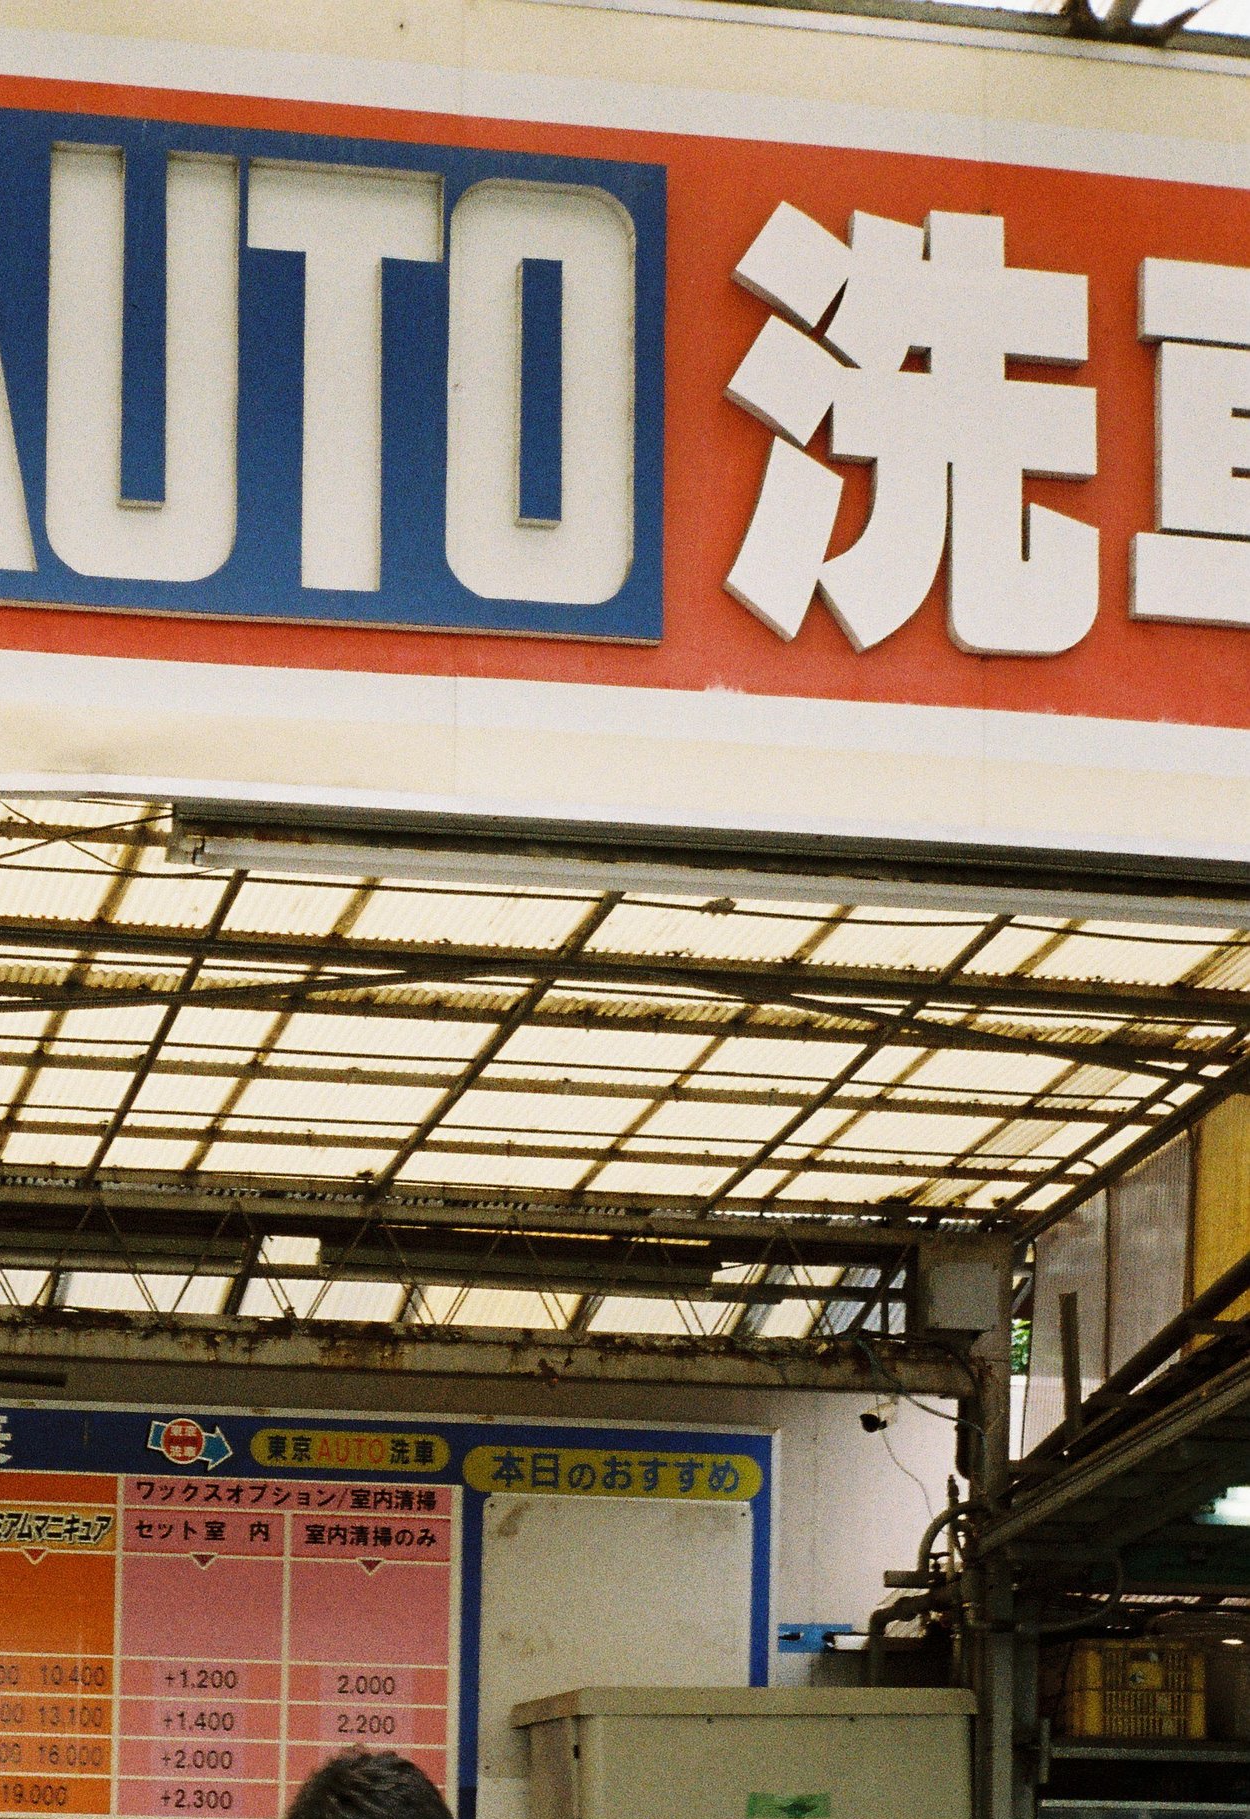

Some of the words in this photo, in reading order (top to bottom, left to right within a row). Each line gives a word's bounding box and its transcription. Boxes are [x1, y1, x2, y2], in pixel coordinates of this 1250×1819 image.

[491, 1450, 740, 1494] 本日のおすすめ
[305, 1523, 437, 1548] 室内清掃のみ
